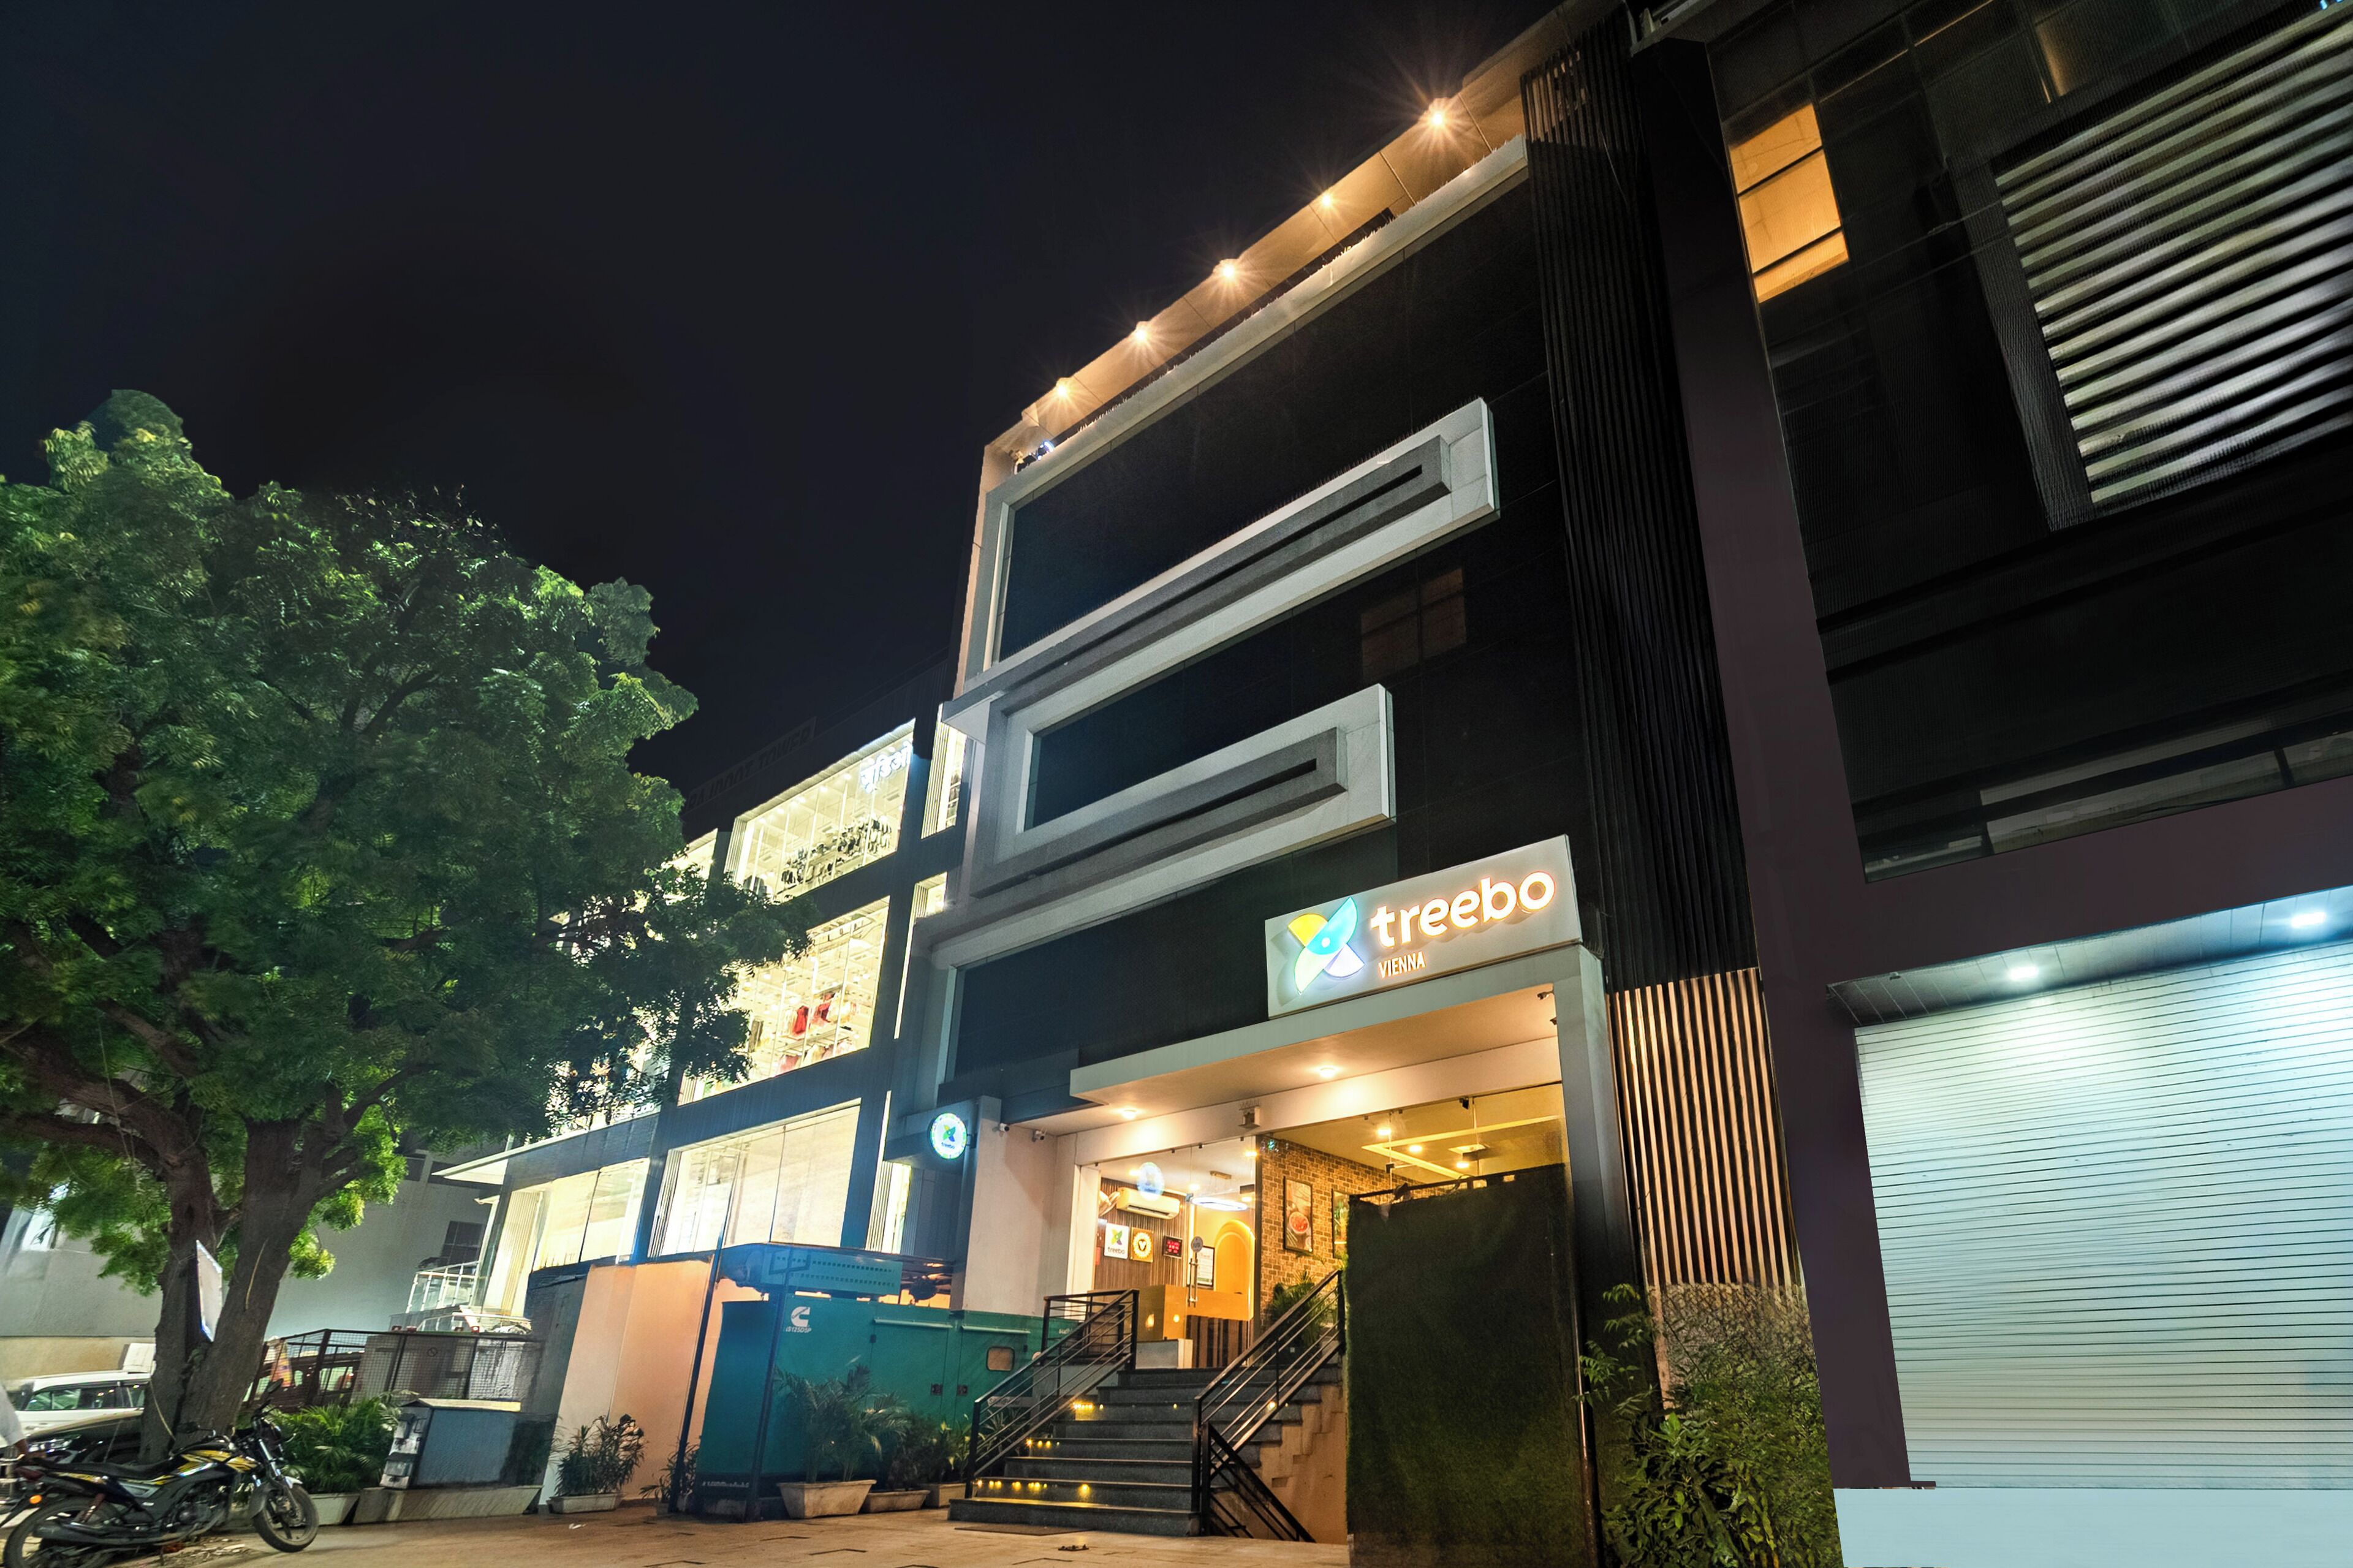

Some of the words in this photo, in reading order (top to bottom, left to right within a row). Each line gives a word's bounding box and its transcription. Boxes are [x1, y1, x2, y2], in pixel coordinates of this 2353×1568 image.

[1370, 871, 1555, 949] treebo
[1378, 952, 1426, 979] VIENNA
[1107, 1246, 1125, 1255] treebo
